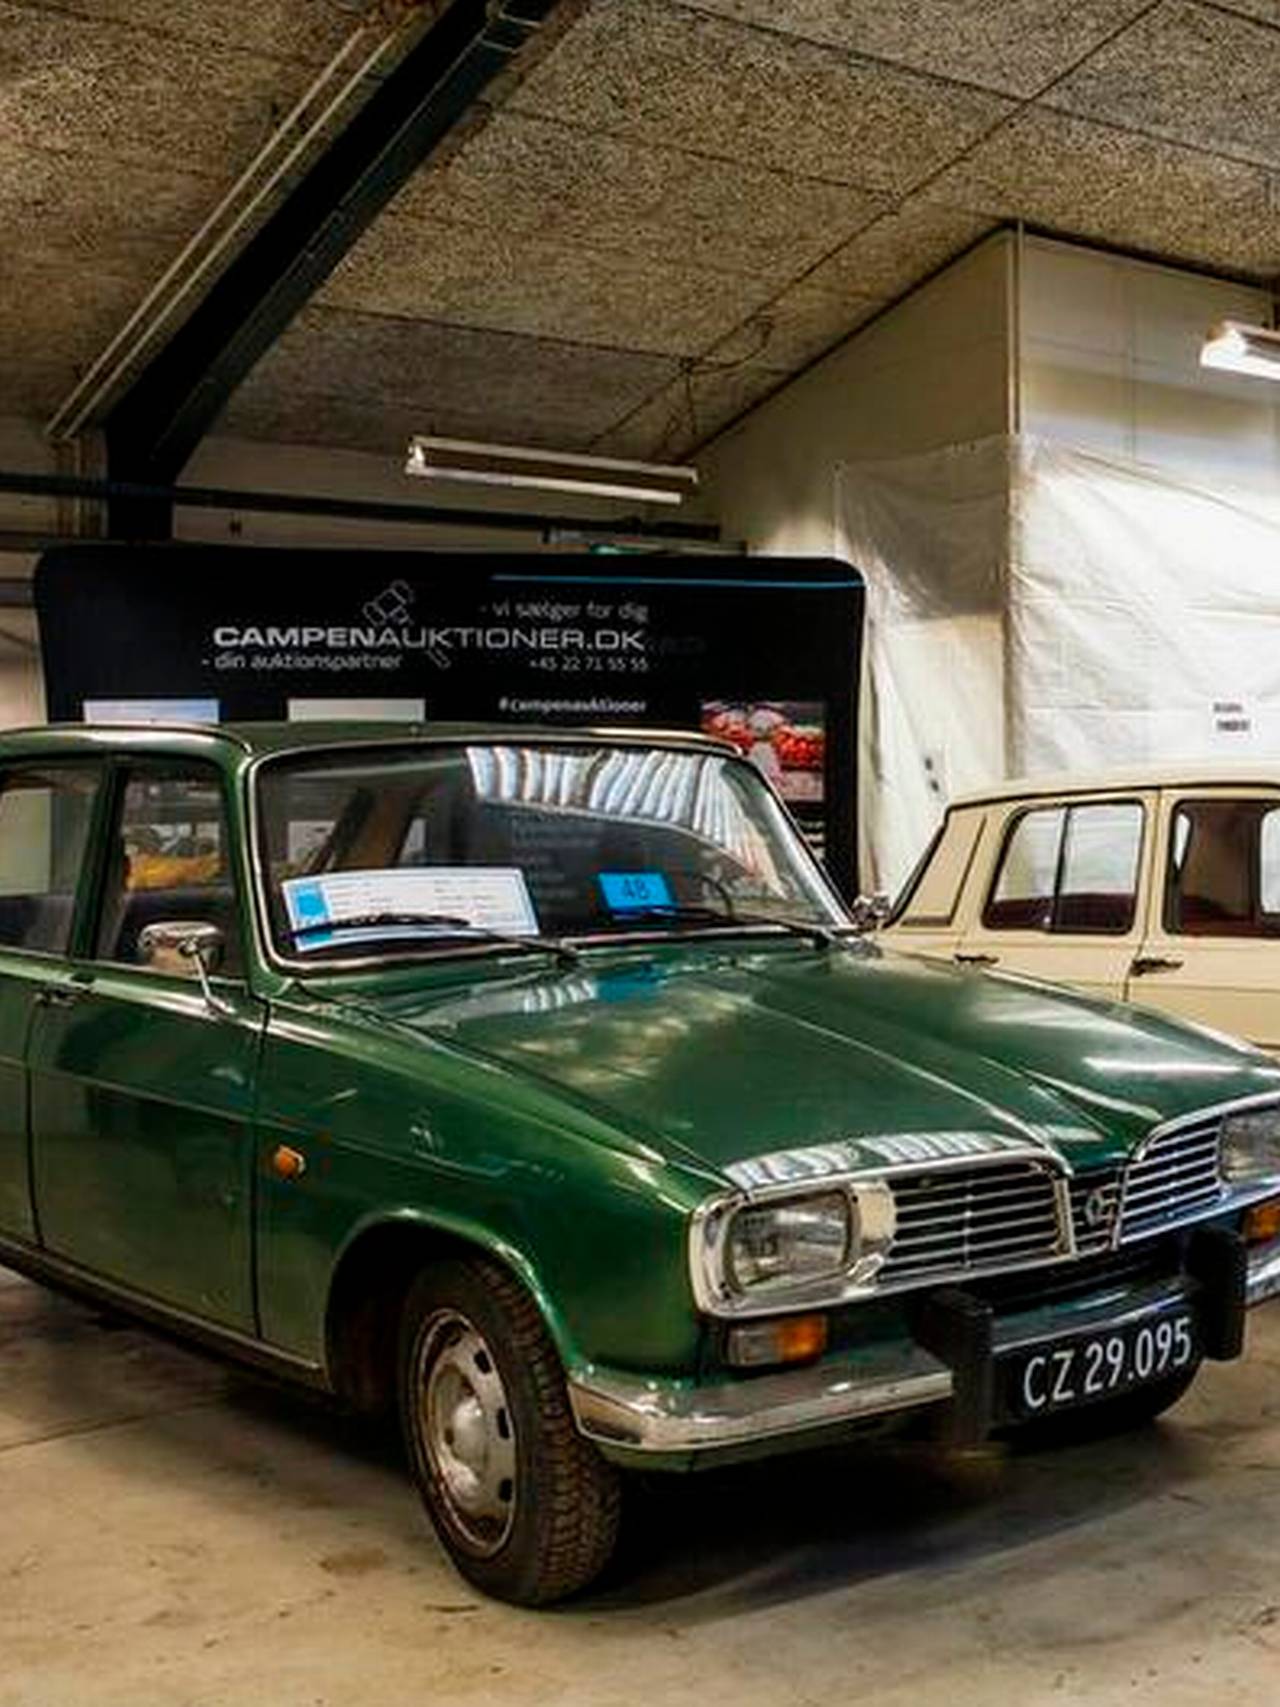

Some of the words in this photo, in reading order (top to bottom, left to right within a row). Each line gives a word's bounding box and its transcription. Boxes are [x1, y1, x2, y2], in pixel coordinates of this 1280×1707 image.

[492, 600, 510, 617] vi
[515, 600, 582, 623] sælger
[586, 601, 614, 619] for
[617, 602, 649, 625] dig
[213, 627, 646, 651] CAMPENAUKTIONER.DK
[214, 651, 246, 669] din
[251, 653, 402, 671] auktionspartner
[530, 656, 557, 672] +45
[562, 656, 582, 672] 22
[498, 696, 647, 715] #campenauktioner
[1023, 1347, 1076, 1410] CZ
[1083, 1316, 1193, 1396] 29.095
